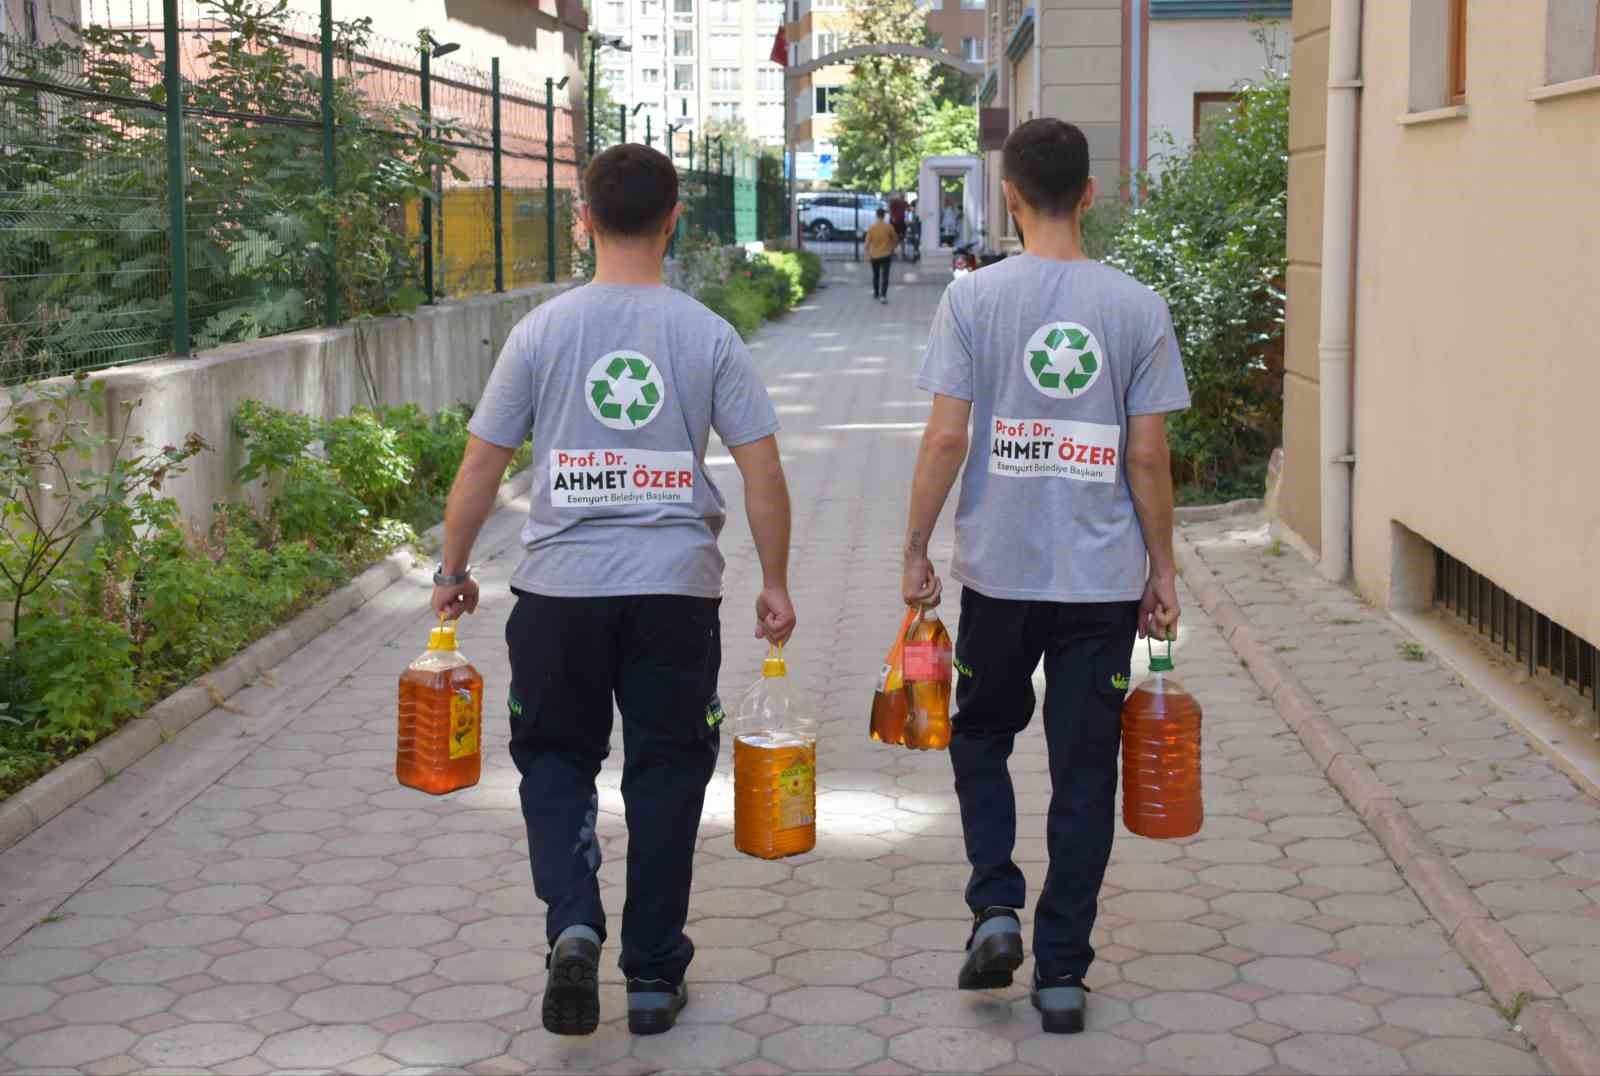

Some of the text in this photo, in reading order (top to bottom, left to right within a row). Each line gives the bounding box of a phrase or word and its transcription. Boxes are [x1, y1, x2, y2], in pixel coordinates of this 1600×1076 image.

[996, 420, 1055, 437] Prof. Dr.
[558, 452, 628, 467] Prof. Dr.
[1058, 437, 1116, 466] ÖZER
[1034, 463, 1068, 474] Belediye
[553, 464, 692, 490] AHMET ÖZER
[567, 494, 608, 505] Esenyurt
